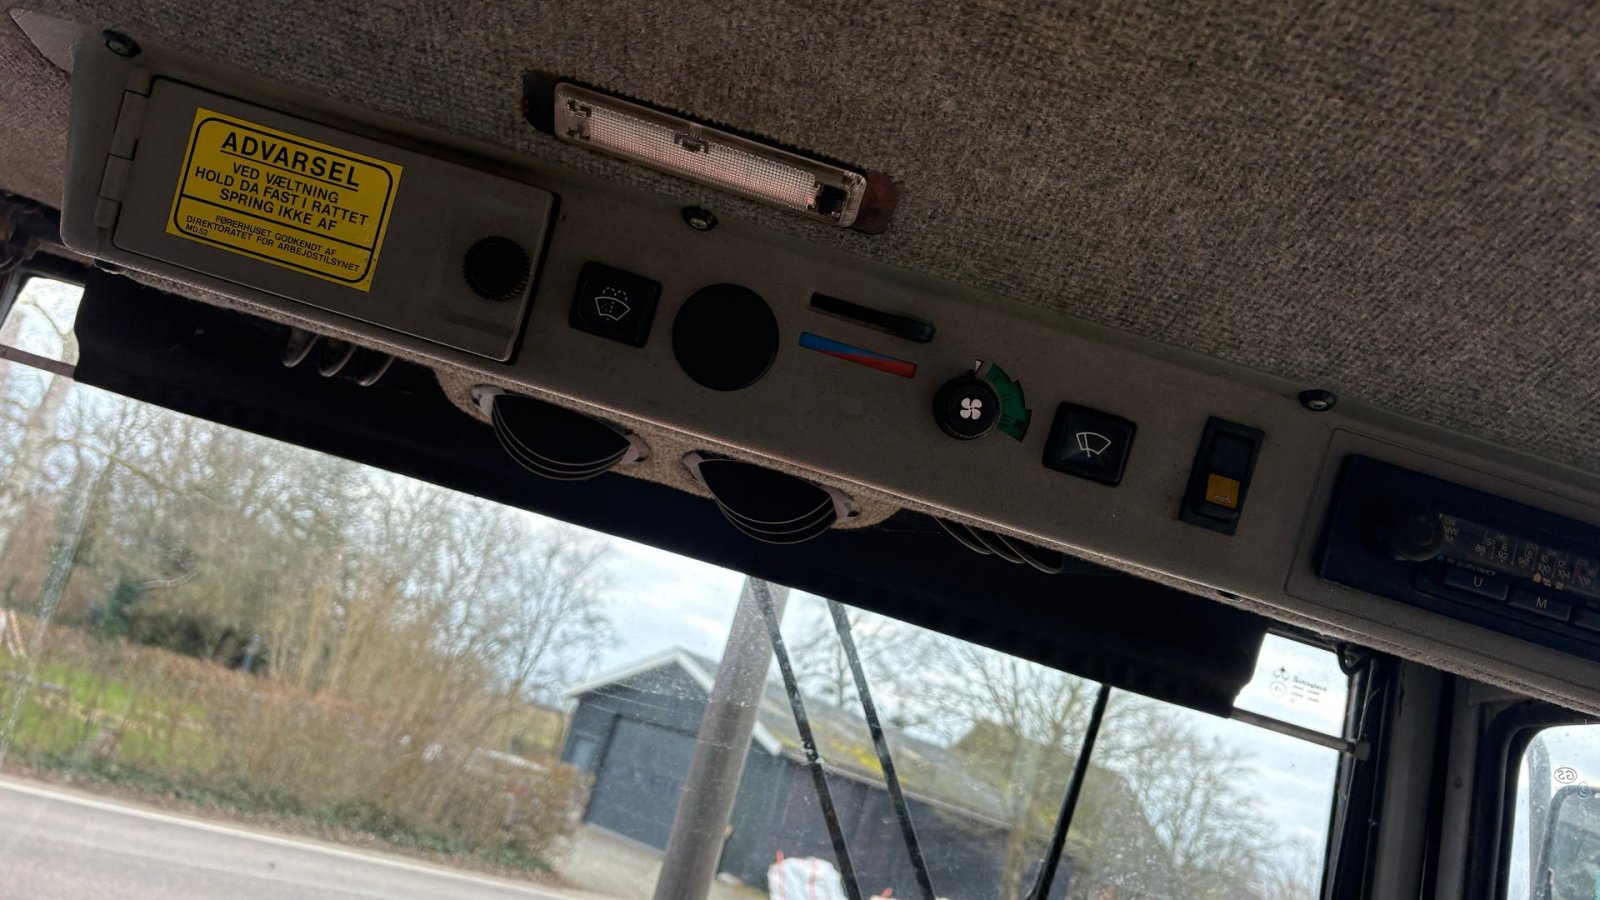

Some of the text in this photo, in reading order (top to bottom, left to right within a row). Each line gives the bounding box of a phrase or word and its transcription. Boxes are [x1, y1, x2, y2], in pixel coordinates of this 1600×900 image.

[221, 131, 360, 187] ADVARSEL
[195, 166, 369, 226] HOLD DA FAST I RATTET
[233, 162, 339, 203] VED VÆLTNING
[220, 189, 338, 231] SPRING IKKE AF
[186, 215, 361, 272] DIREKTORATET FOR ARBEJDSTILSYNET
[215, 215, 337, 256] FØRERHUSET GODKENDT AF
[1475, 544, 1486, 553] 88
[1497, 550, 1509, 561] 92
[1473, 575, 1483, 587] U
[1536, 597, 1548, 609] M
